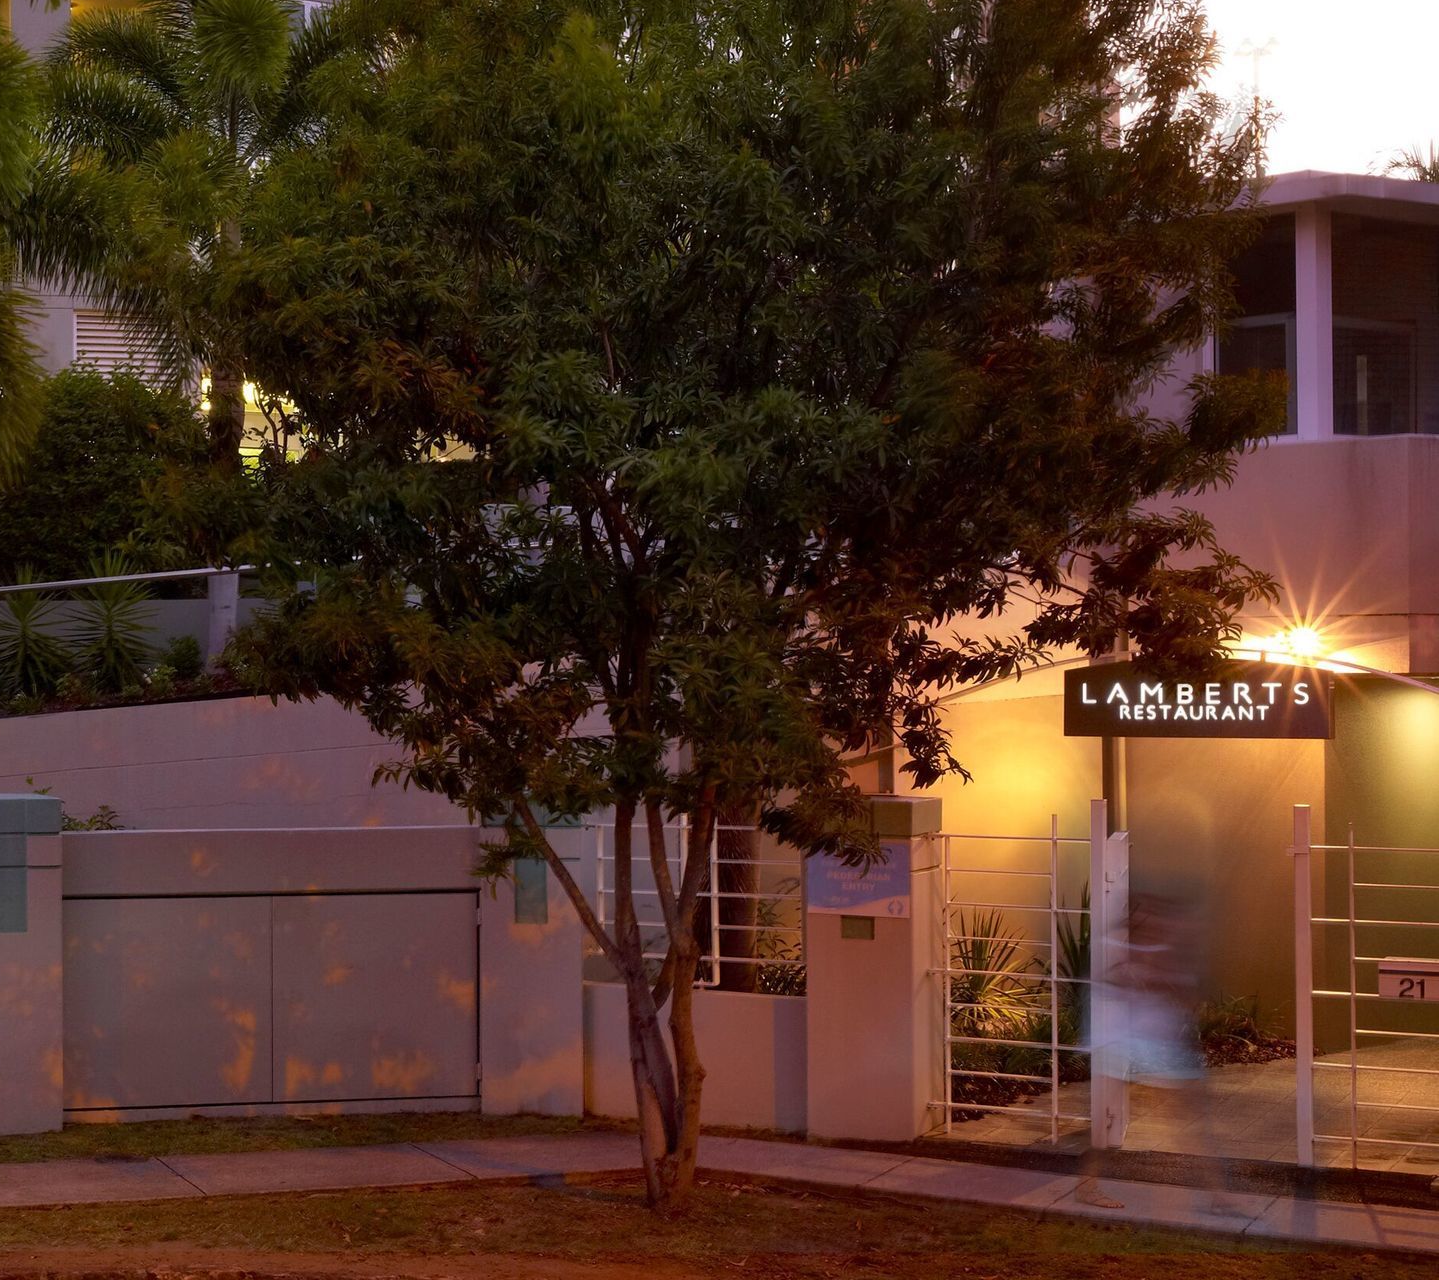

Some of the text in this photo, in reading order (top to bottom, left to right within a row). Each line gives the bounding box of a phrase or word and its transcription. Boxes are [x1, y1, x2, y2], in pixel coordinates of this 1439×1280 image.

[1081, 682, 1310, 705] LAMBERTS
[1118, 705, 1270, 721] RESTAURANT
[1398, 978, 1426, 999] 21
